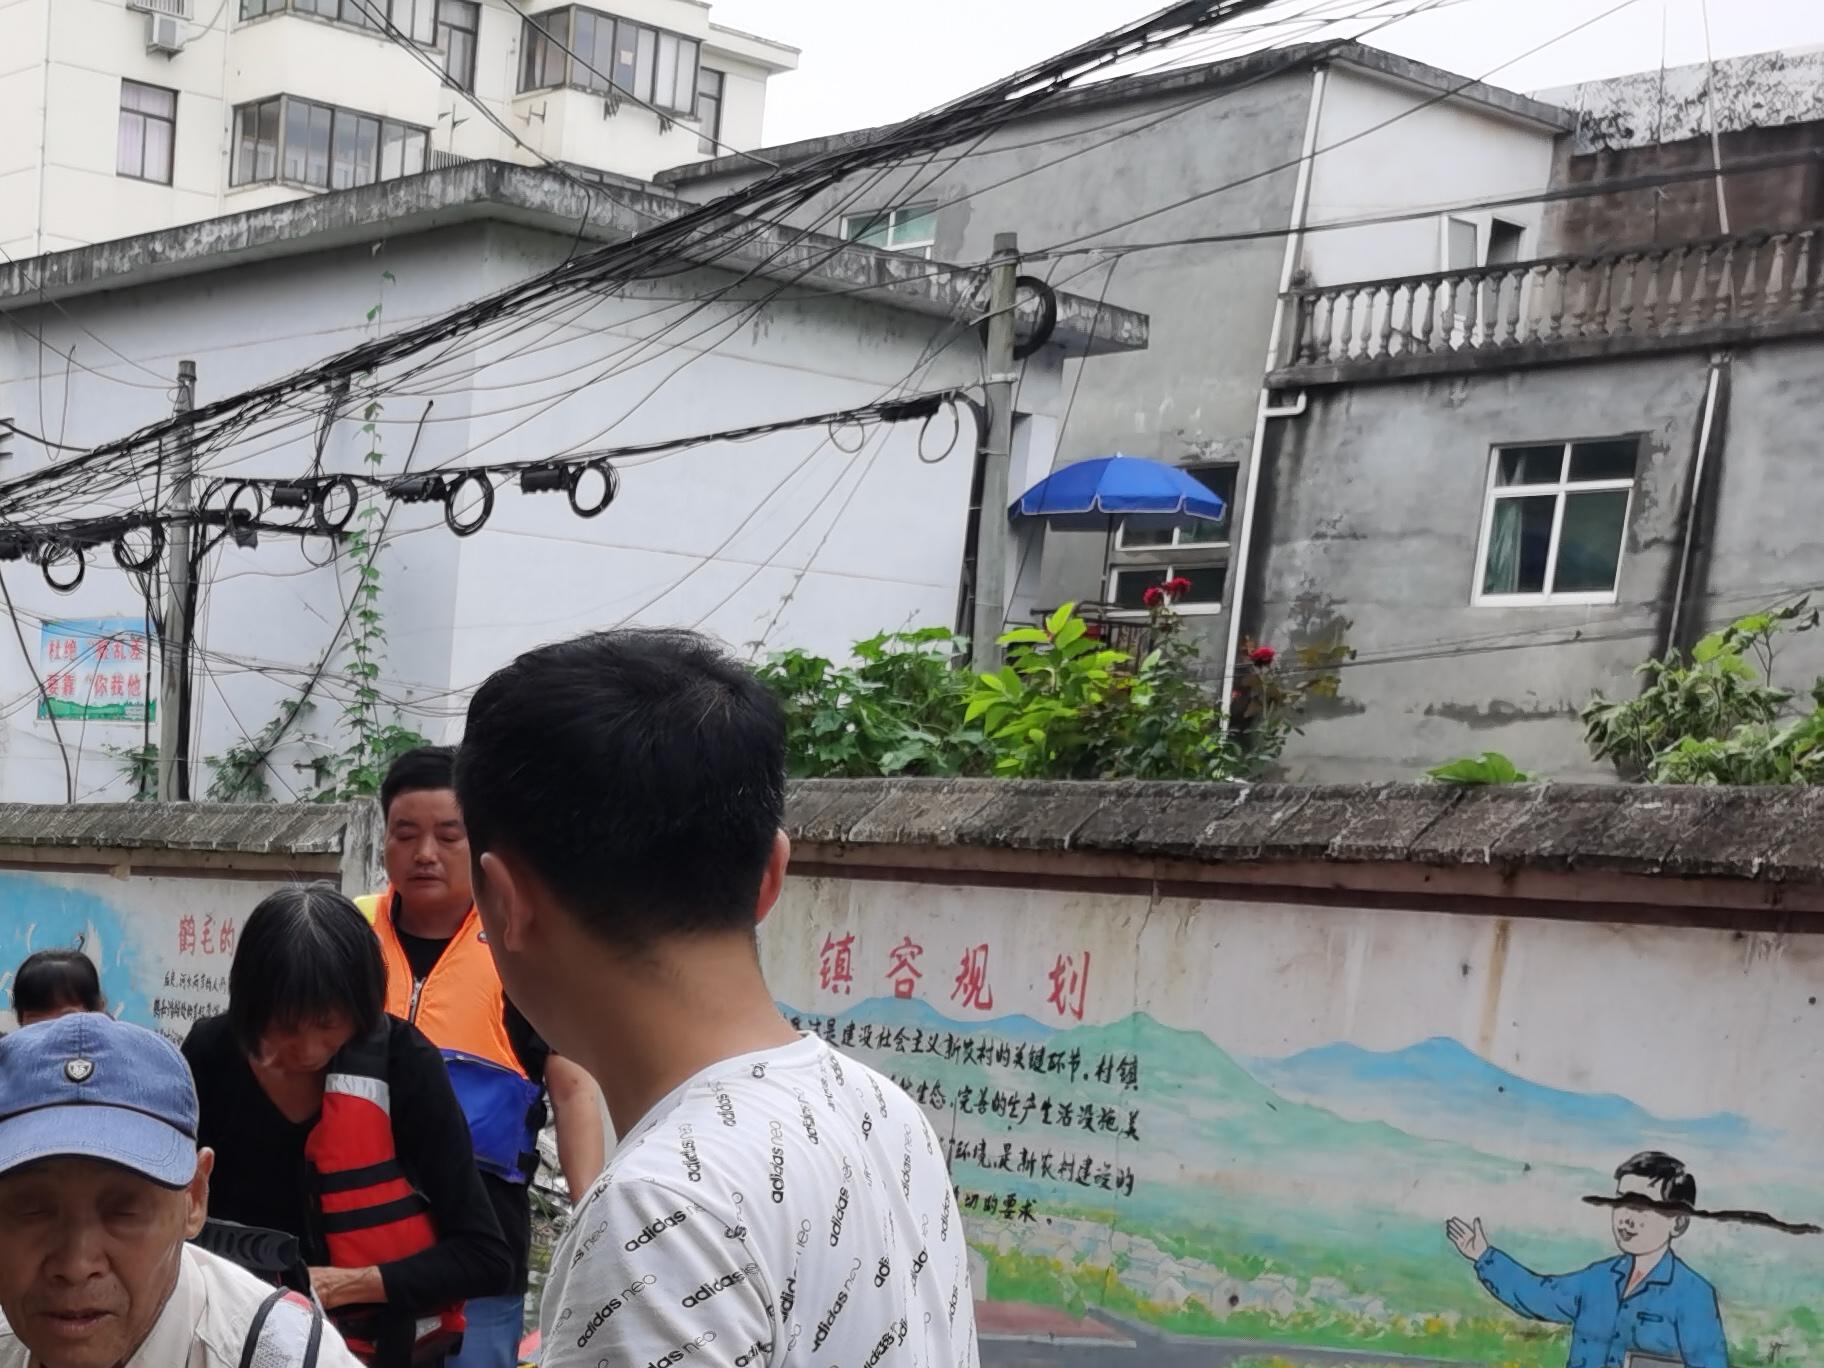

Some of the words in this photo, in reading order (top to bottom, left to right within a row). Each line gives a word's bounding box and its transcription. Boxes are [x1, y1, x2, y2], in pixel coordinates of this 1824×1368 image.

[819, 931, 1090, 1021] 镇容规划
[625, 1210, 687, 1252] adidas
[830, 1186, 849, 1247] adidas
[576, 1298, 622, 1348] adidas
[620, 1275, 657, 1301] neo
[681, 1271, 746, 1309] adidas
